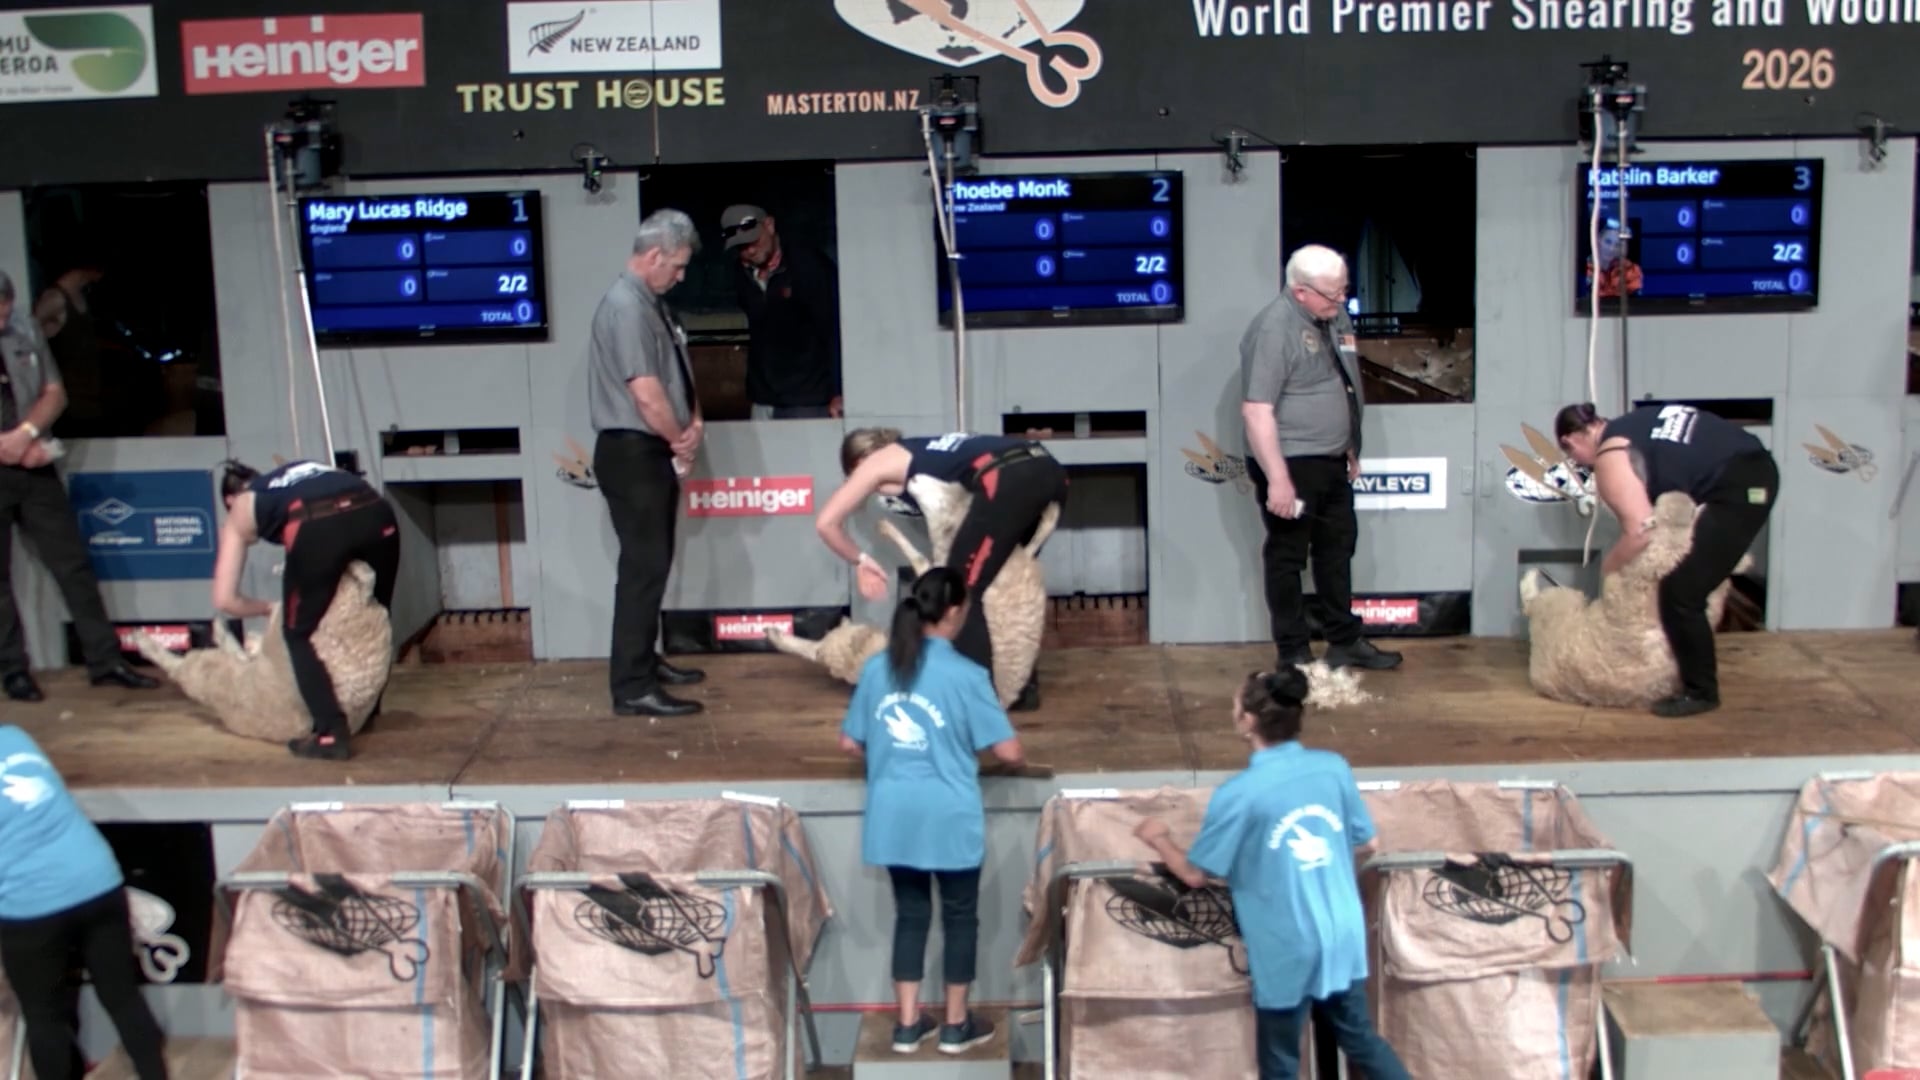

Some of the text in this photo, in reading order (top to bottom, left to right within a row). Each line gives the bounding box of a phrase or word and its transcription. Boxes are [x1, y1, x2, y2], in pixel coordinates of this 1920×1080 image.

[1194, 0, 1310, 36] World
[1332, 0, 1493, 34] Premier
[1511, 0, 1695, 35] Shearing
[1712, 0, 1783, 26] and
[193, 15, 418, 84] Heiniger
[570, 35, 701, 53] NEW ZEALAND
[1741, 48, 1835, 90] 2026
[456, 77, 726, 113] TRUST HOUSE
[767, 89, 920, 116] MASTERTON.NZ
[1656, 167, 1719, 186] Barker
[1793, 166, 1811, 191] 3
[1018, 180, 1071, 198] Monk
[1152, 179, 1170, 203] 2
[309, 200, 468, 223] Mary Lucas Ridge
[512, 200, 529, 223] 1
[1677, 208, 1690, 227] 0
[1791, 206, 1804, 225] 0
[1037, 222, 1050, 240] 0
[1152, 218, 1166, 238] 0
[402, 241, 414, 259] 0
[513, 238, 526, 256] 0
[1676, 244, 1689, 264] 0
[1773, 243, 1803, 262] 2/2
[1038, 258, 1052, 277] 0
[1136, 255, 1166, 274] 2/2
[404, 278, 417, 296] 0
[498, 274, 529, 293] 2/2
[1752, 270, 1804, 292] TOTAL 0
[1117, 282, 1169, 303] TOTAL 0
[481, 301, 533, 322] TOTAL 0
[1352, 476, 1427, 492] AYLEYS
[689, 477, 811, 513] Heiniger
[1350, 600, 1415, 623] einiger
